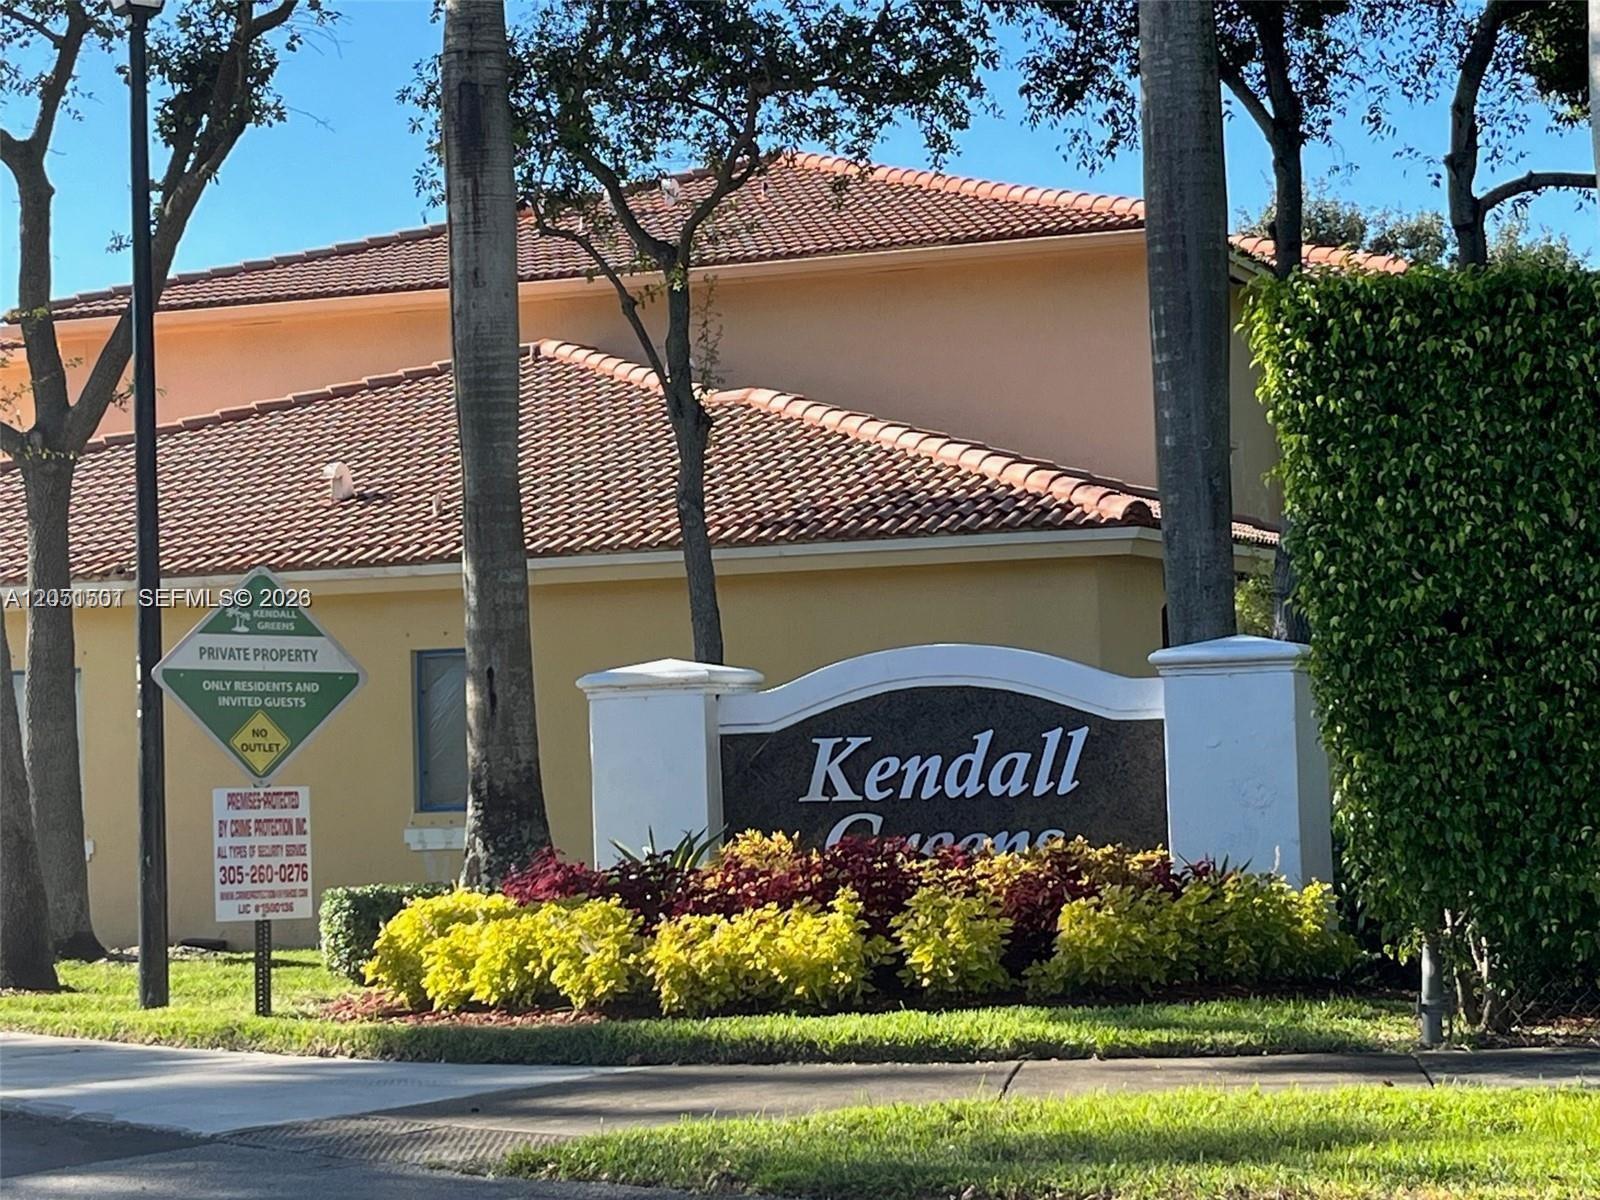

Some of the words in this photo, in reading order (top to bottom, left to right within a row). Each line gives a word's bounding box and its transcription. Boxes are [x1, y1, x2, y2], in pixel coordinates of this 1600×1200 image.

[252, 610, 297, 619] KENDALL
[257, 621, 295, 631] GREENS
[199, 646, 250, 661] PRIVATE
[252, 648, 318, 663] PROPERTY
[202, 680, 232, 691] ONLY
[234, 681, 293, 693] RESIDENTS
[294, 682, 320, 693] AND
[218, 696, 262, 707] INVITED
[263, 697, 306, 708] GUESTS
[251, 728, 268, 738] NO
[240, 743, 281, 753] OUTLET
[798, 725, 1089, 803] Kendall
[218, 819, 228, 838] BY
[230, 818, 252, 838] CRIME
[254, 818, 294, 837] PROTECTION
[217, 845, 228, 859] ALL
[229, 845, 248, 859] TYPES
[248, 844, 256, 858] OF
[257, 844, 284, 858] SECURITY
[285, 843, 307, 857] SERVICE
[219, 863, 309, 885] 305-260-0276
